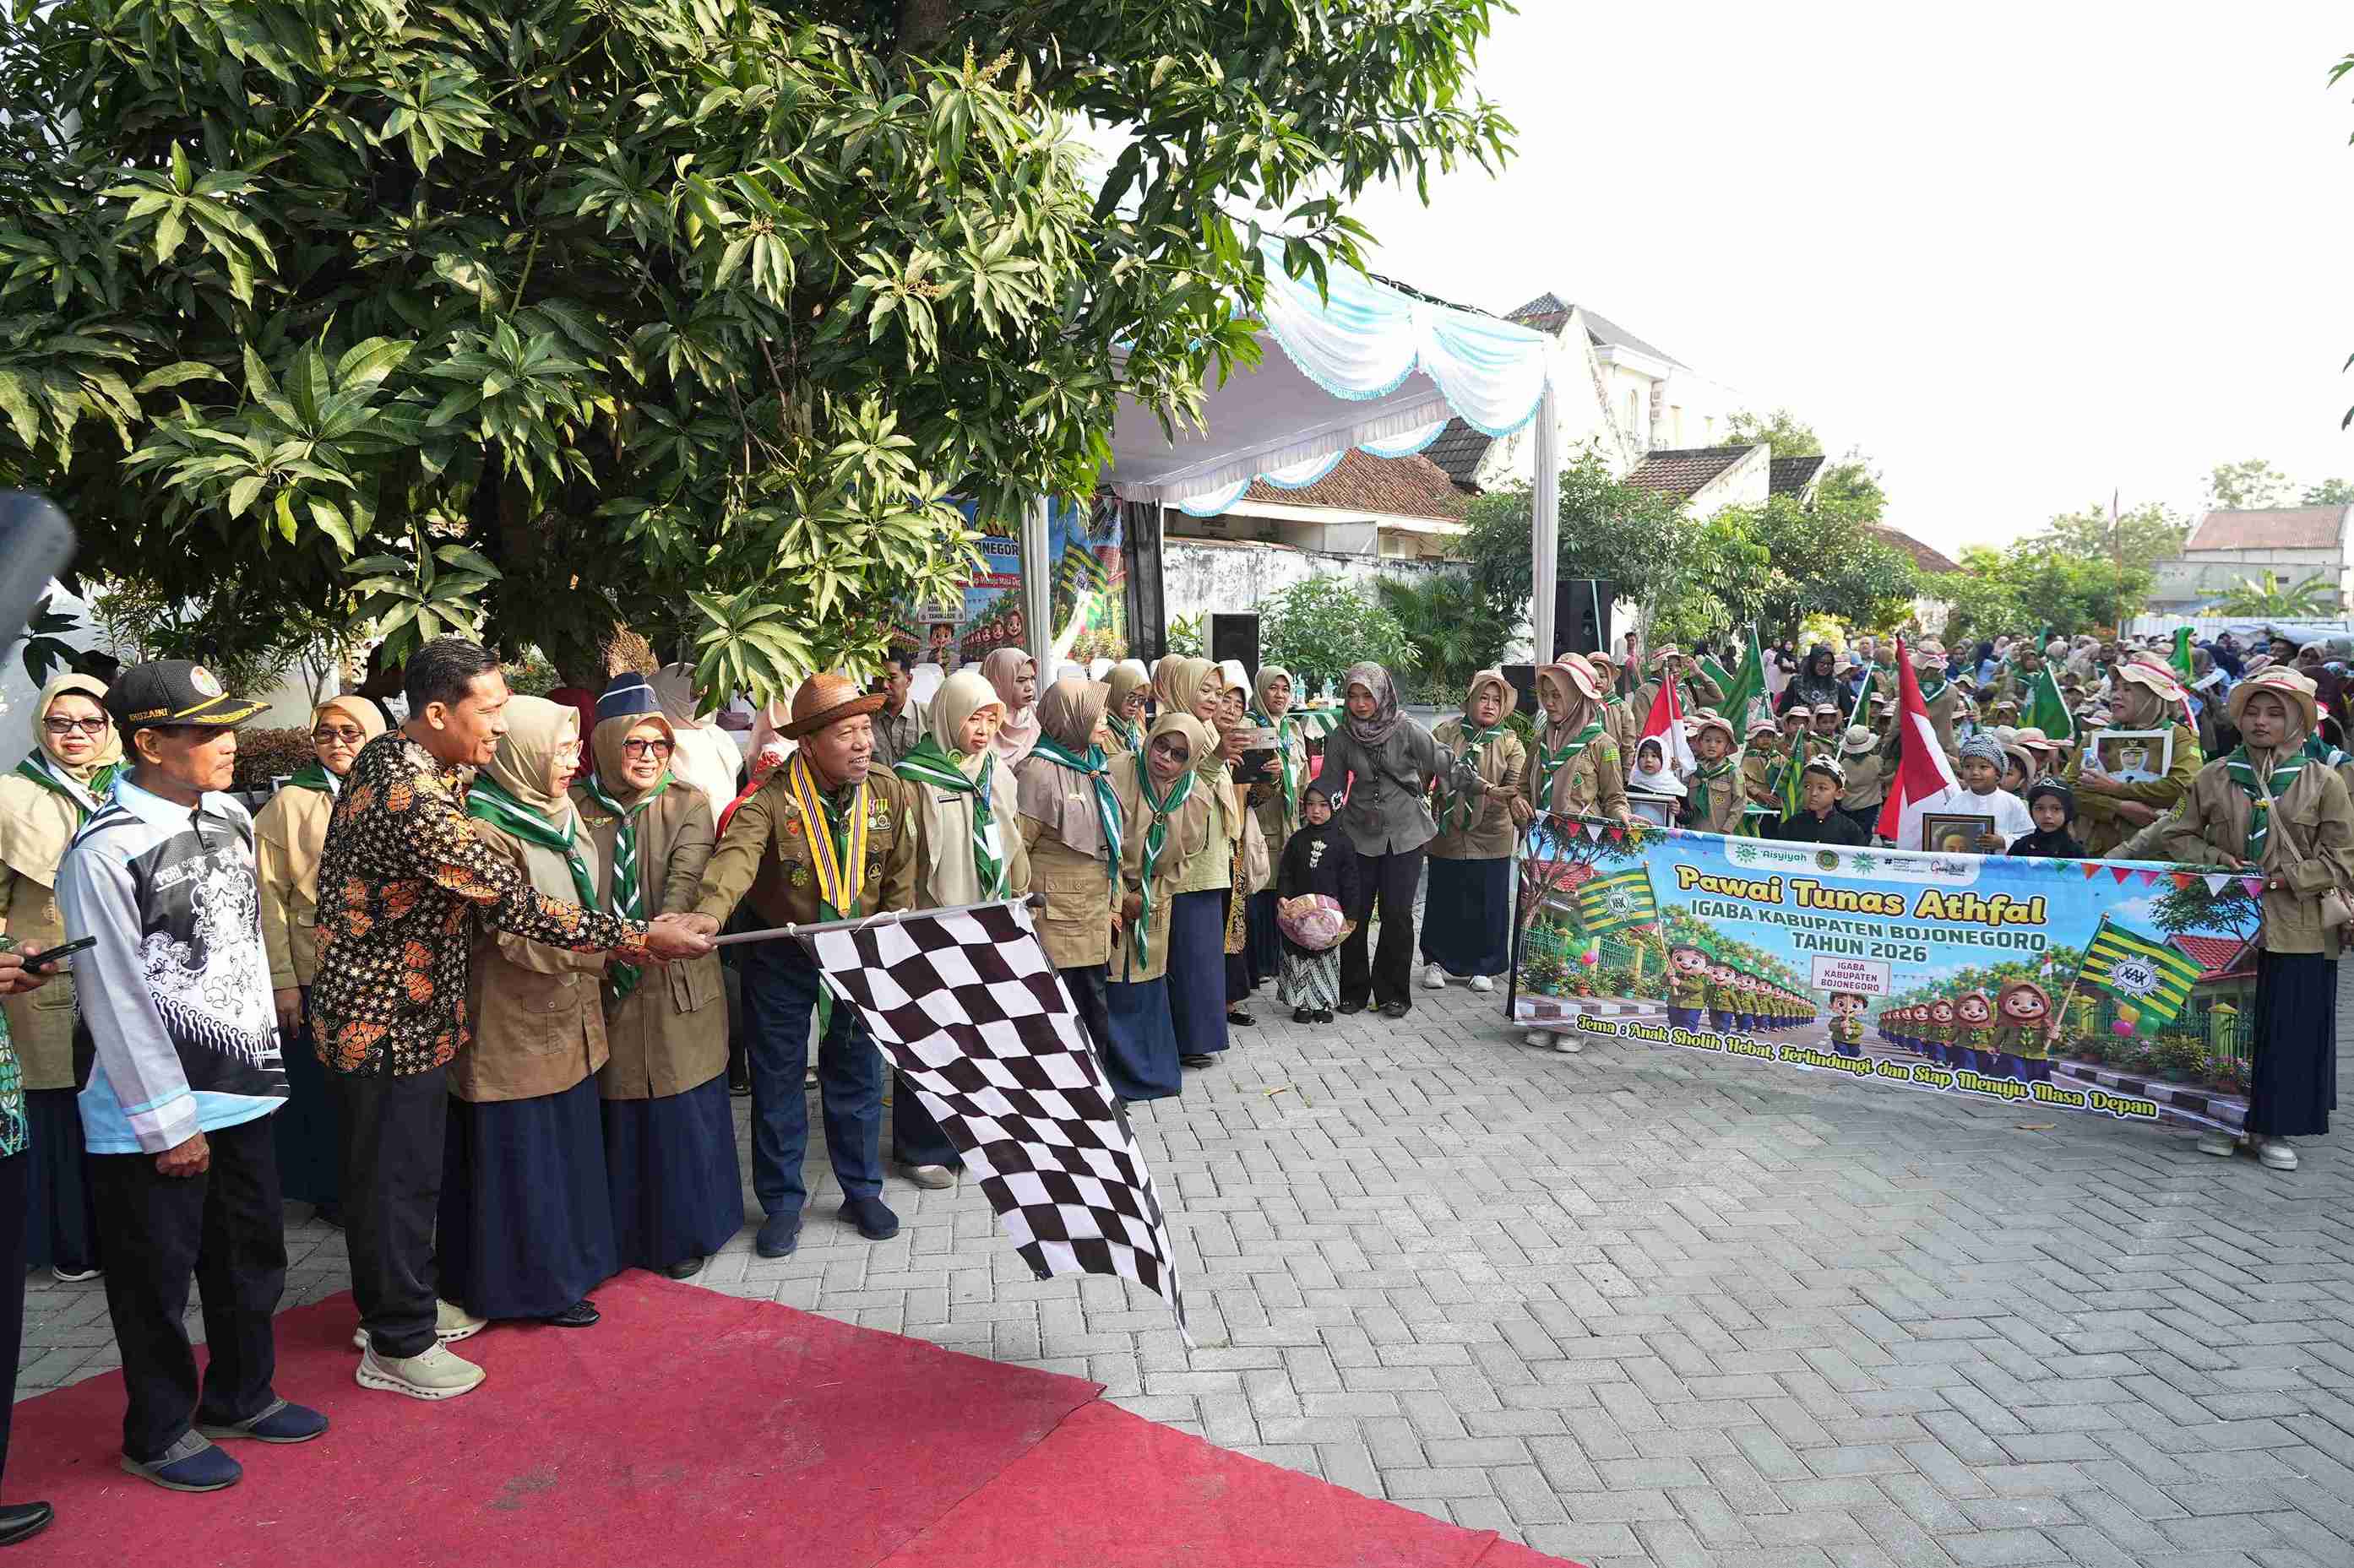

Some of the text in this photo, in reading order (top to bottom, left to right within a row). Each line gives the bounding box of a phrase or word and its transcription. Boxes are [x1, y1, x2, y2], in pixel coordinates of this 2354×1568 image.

[974, 541, 1019, 556] ONEGOR
[155, 864, 183, 886] PGRI
[1675, 865, 2047, 926] Pawai Tunas Athfal
[1692, 899, 2046, 952] IGABA KABUPATEN BOJONEGORO
[1792, 931, 1927, 963] TAHUN 2026
[1824, 969, 1878, 982] KABUPATEN
[1837, 962, 1866, 972] IGABA
[1821, 979, 1879, 992] BOJONEGORO
[1577, 1014, 1617, 1035] Tema
[1628, 1023, 1670, 1044] Anak
[1671, 1028, 1722, 1052] Sholih
[1726, 1036, 1775, 1061] Hebat,
[1780, 1045, 1875, 1077] Terlindungi
[1876, 1060, 1910, 1080] dan
[1913, 1066, 1953, 1089] Siap
[1956, 1071, 2029, 1099] Menuju
[2029, 1082, 2085, 1106] Masa
[2090, 1091, 2156, 1117] Depan
